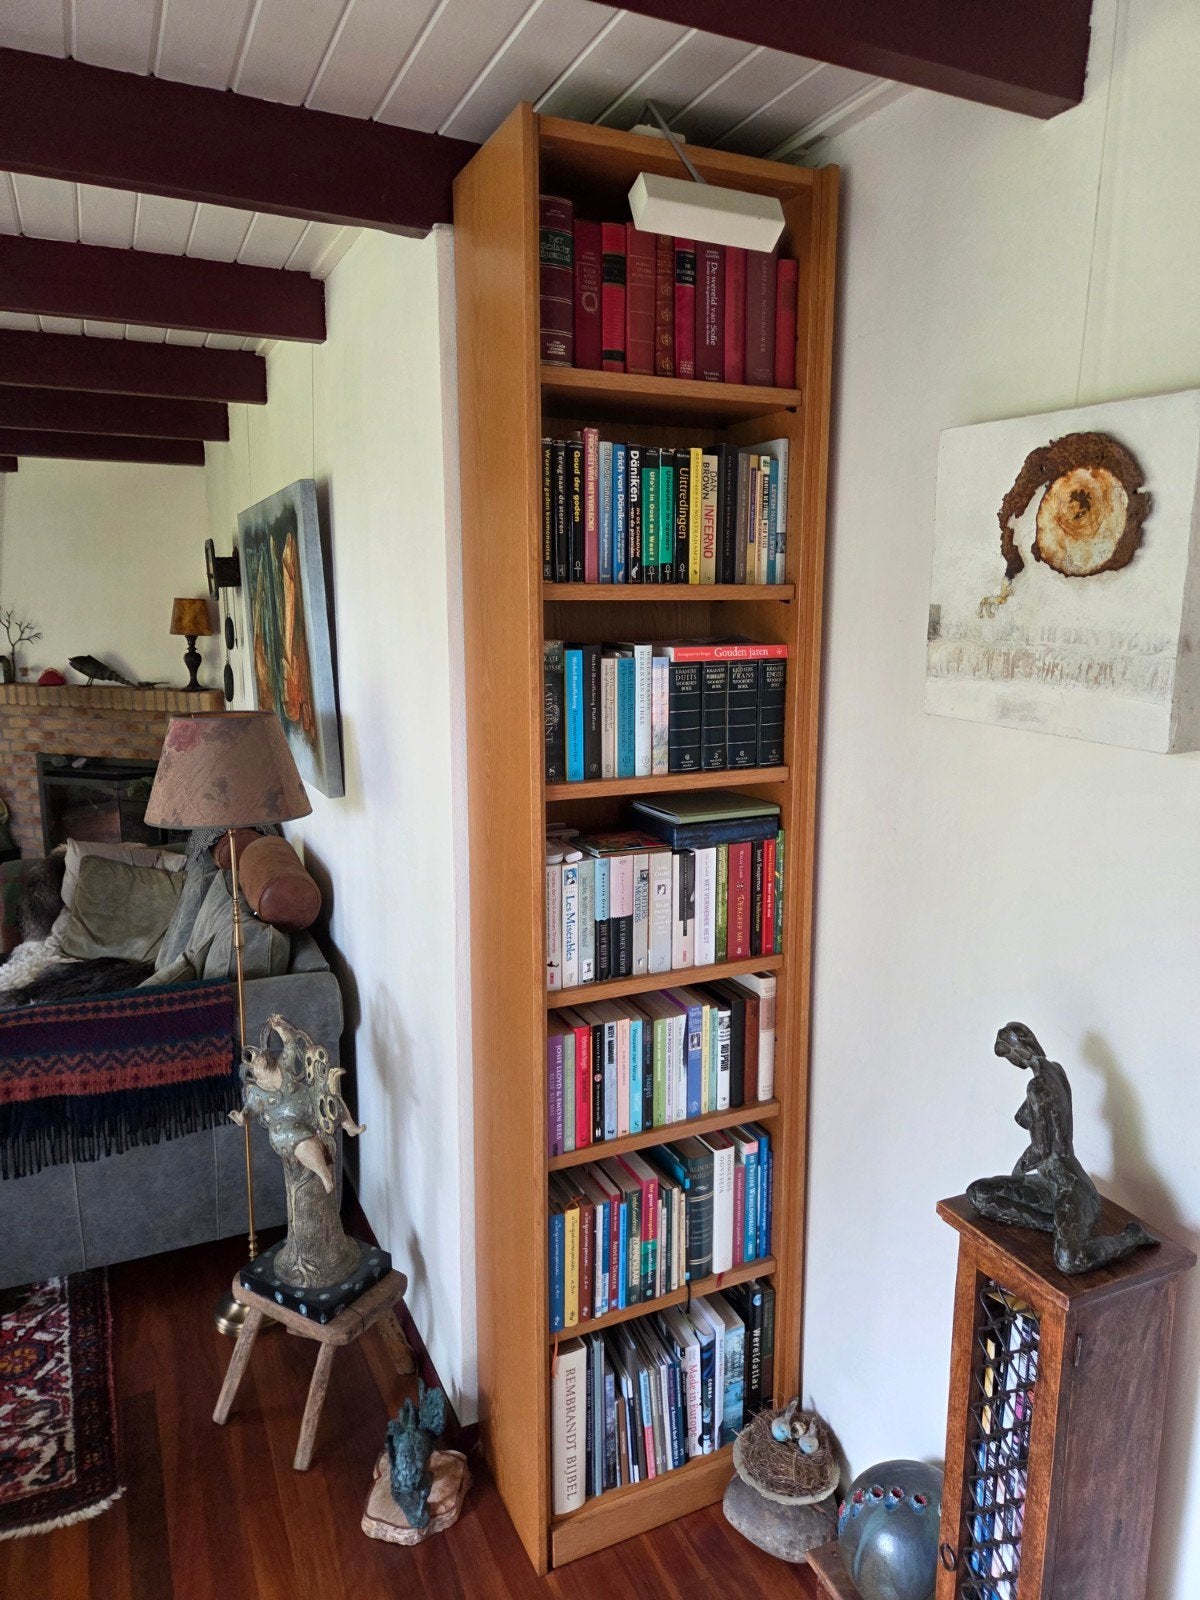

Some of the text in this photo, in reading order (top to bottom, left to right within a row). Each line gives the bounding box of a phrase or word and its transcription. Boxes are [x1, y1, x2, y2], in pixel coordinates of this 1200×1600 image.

[710, 262, 718, 274] De
[710, 324, 718, 346] Sofie
[556, 450, 565, 474] Terug
[630, 450, 640, 502] Däniken
[545, 479, 552, 487] de
[588, 433, 596, 532] PROFEET VAN HET VERLEDEN
[702, 462, 710, 500] BROWN
[710, 470, 718, 492] DAN
[544, 488, 552, 510] goden
[558, 495, 565, 504] de
[572, 494, 581, 522] goden
[636, 507, 641, 515] IN
[649, 493, 655, 502] in
[676, 467, 690, 539] Uittredingen
[618, 494, 626, 532] Däniken
[630, 520, 636, 528] de
[636, 516, 641, 525] DE
[665, 512, 672, 522] in
[649, 524, 654, 534] en
[703, 504, 716, 560] INFERNO
[714, 646, 748, 658] Gouden
[749, 648, 768, 658] jaren
[640, 693, 645, 704] DE
[634, 885, 642, 924] MOEDERS
[641, 881, 649, 920] DOCHTERS
[565, 894, 576, 962] Les Misérables
[720, 1043, 730, 1072] AU PAIR
[748, 1155, 756, 1236] DE TWEEDE WERELDOORLOG
[631, 1192, 640, 1234] Linda Goodman
[630, 1236, 642, 1286] ZONNEKLAAR
[751, 1328, 762, 1390] Wereldatlas
[688, 1364, 700, 1438] Made in Europe
[563, 1368, 578, 1501] REMBRANDT BIJBEL
